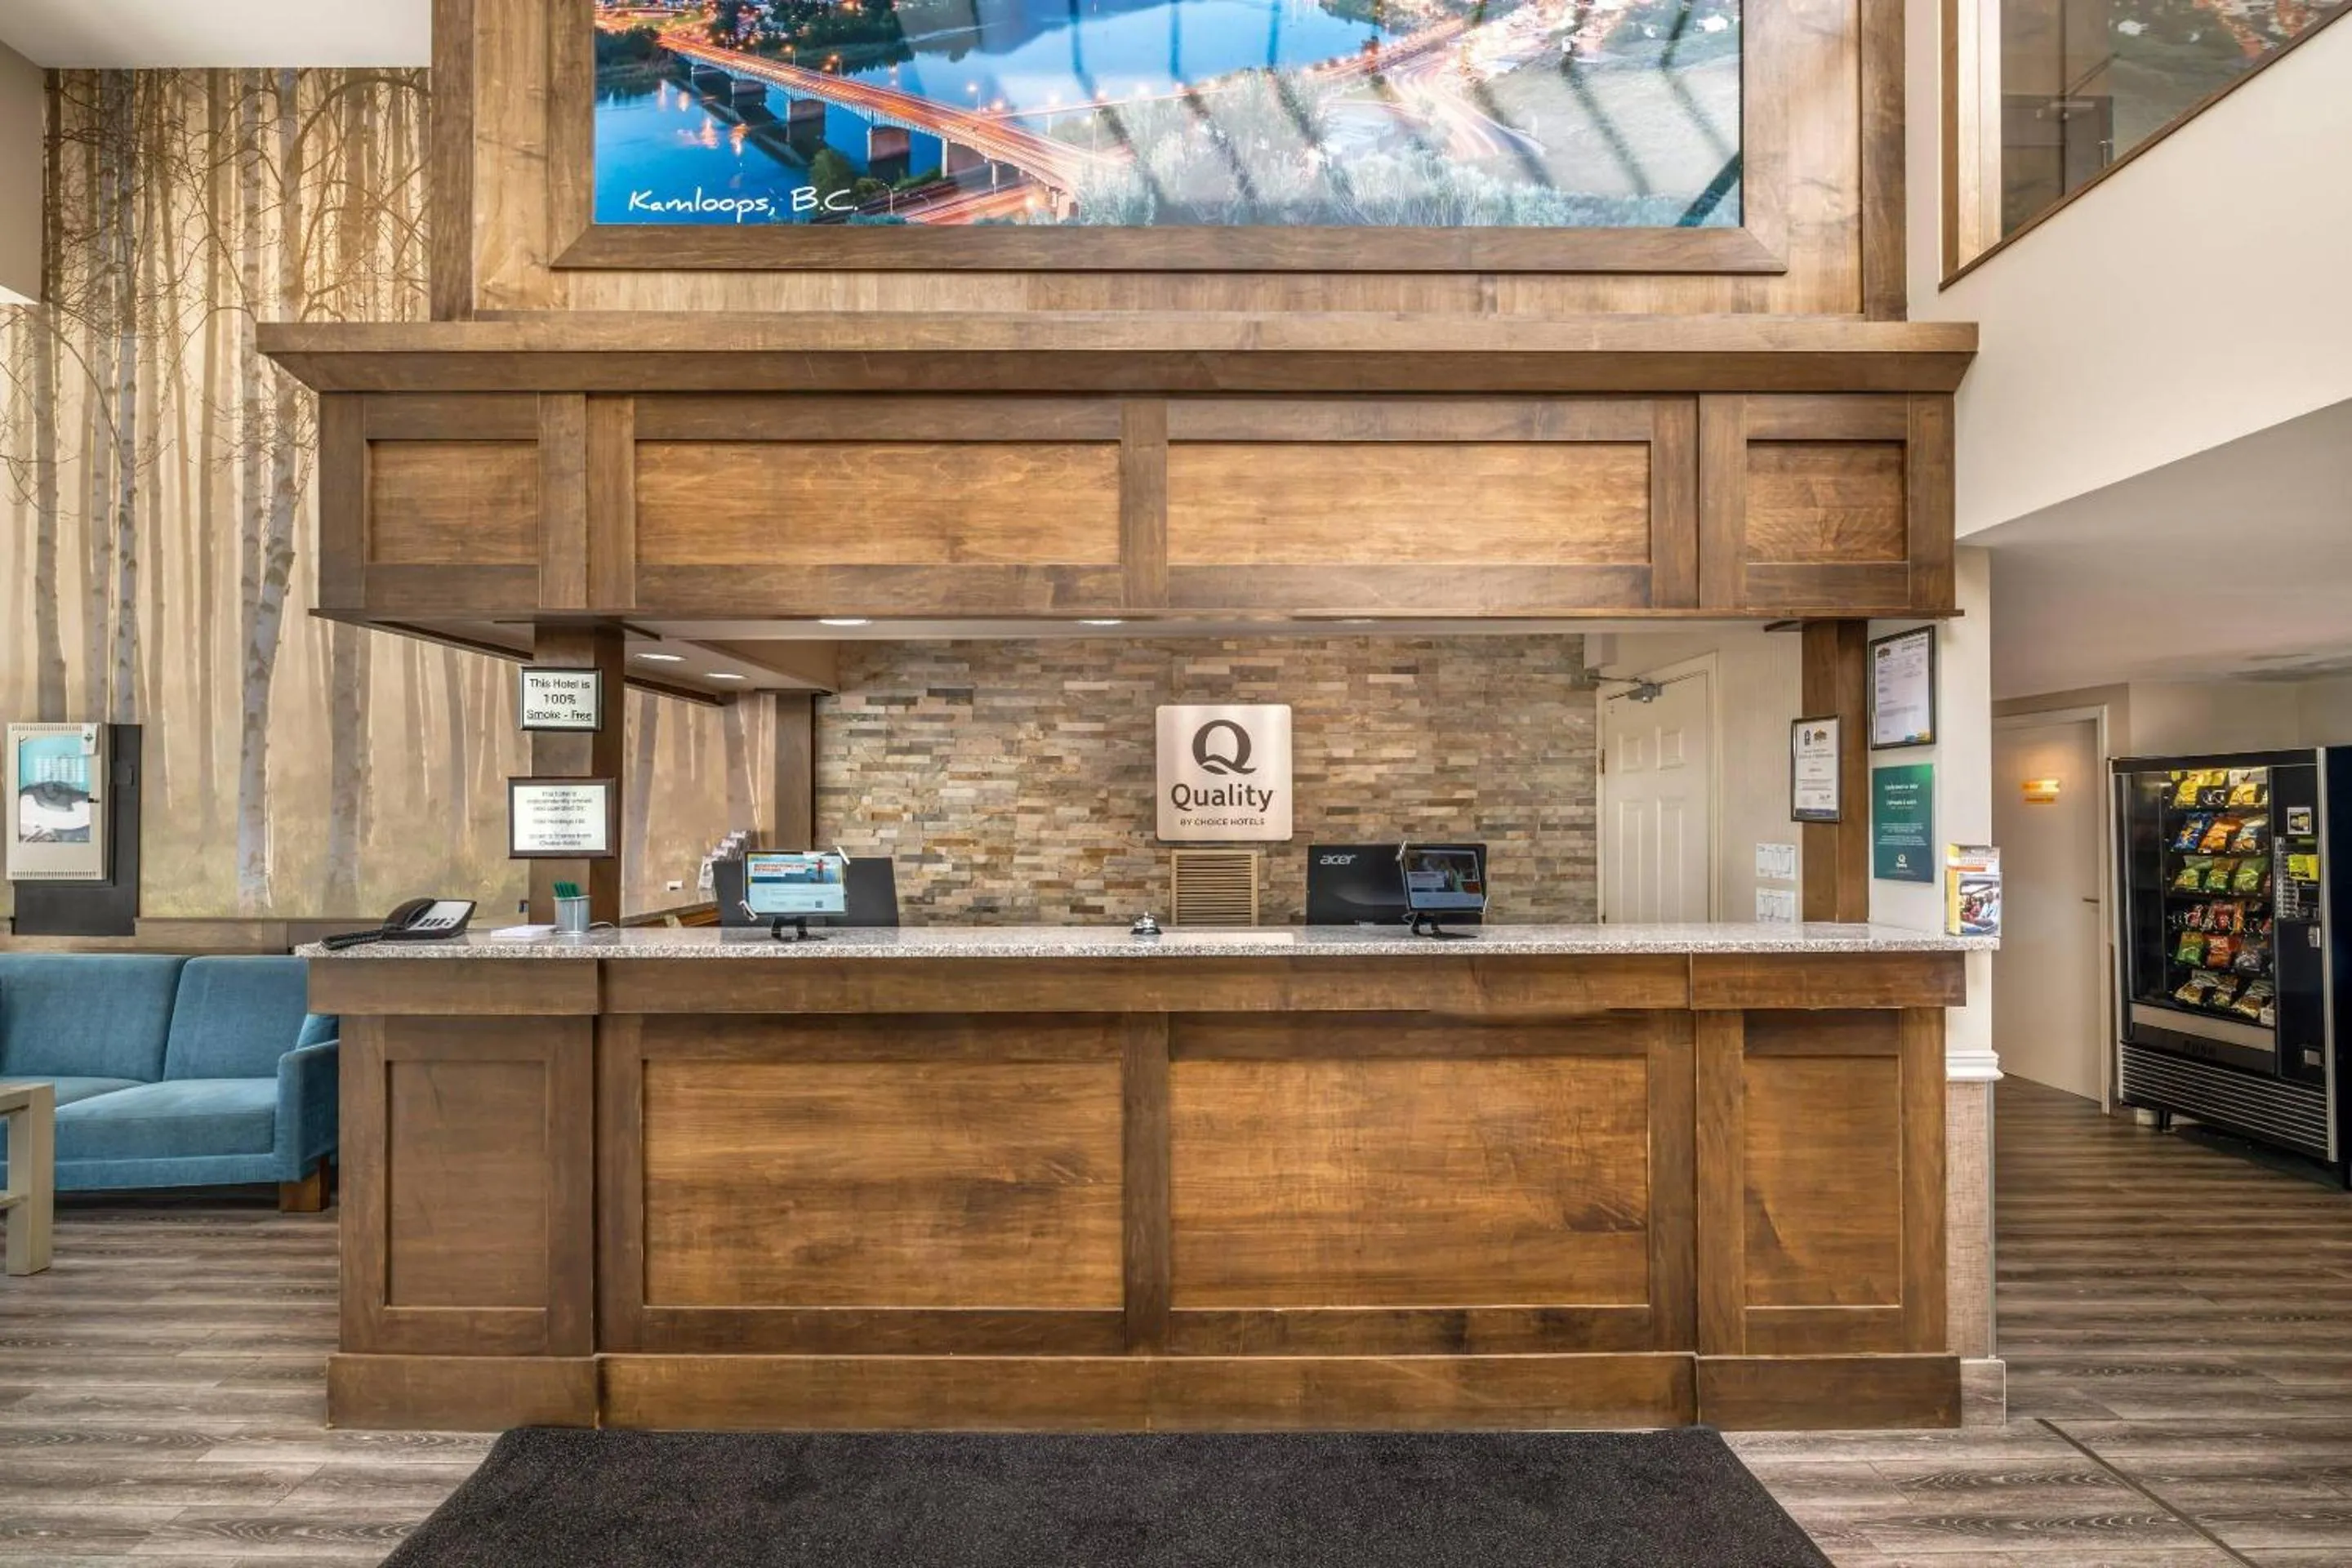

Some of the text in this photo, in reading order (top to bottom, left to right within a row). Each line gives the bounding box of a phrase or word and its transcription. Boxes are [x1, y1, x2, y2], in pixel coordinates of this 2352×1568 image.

[628, 186, 859, 223] Kamloops, B.C.
[529, 678, 590, 689] This Hotel is
[543, 693, 577, 705] 100%
[527, 709, 561, 719] Smoke
[572, 710, 593, 721] Free
[1192, 719, 1257, 775] Q
[1170, 783, 1274, 813] Quality
[1319, 854, 1356, 865] acer
